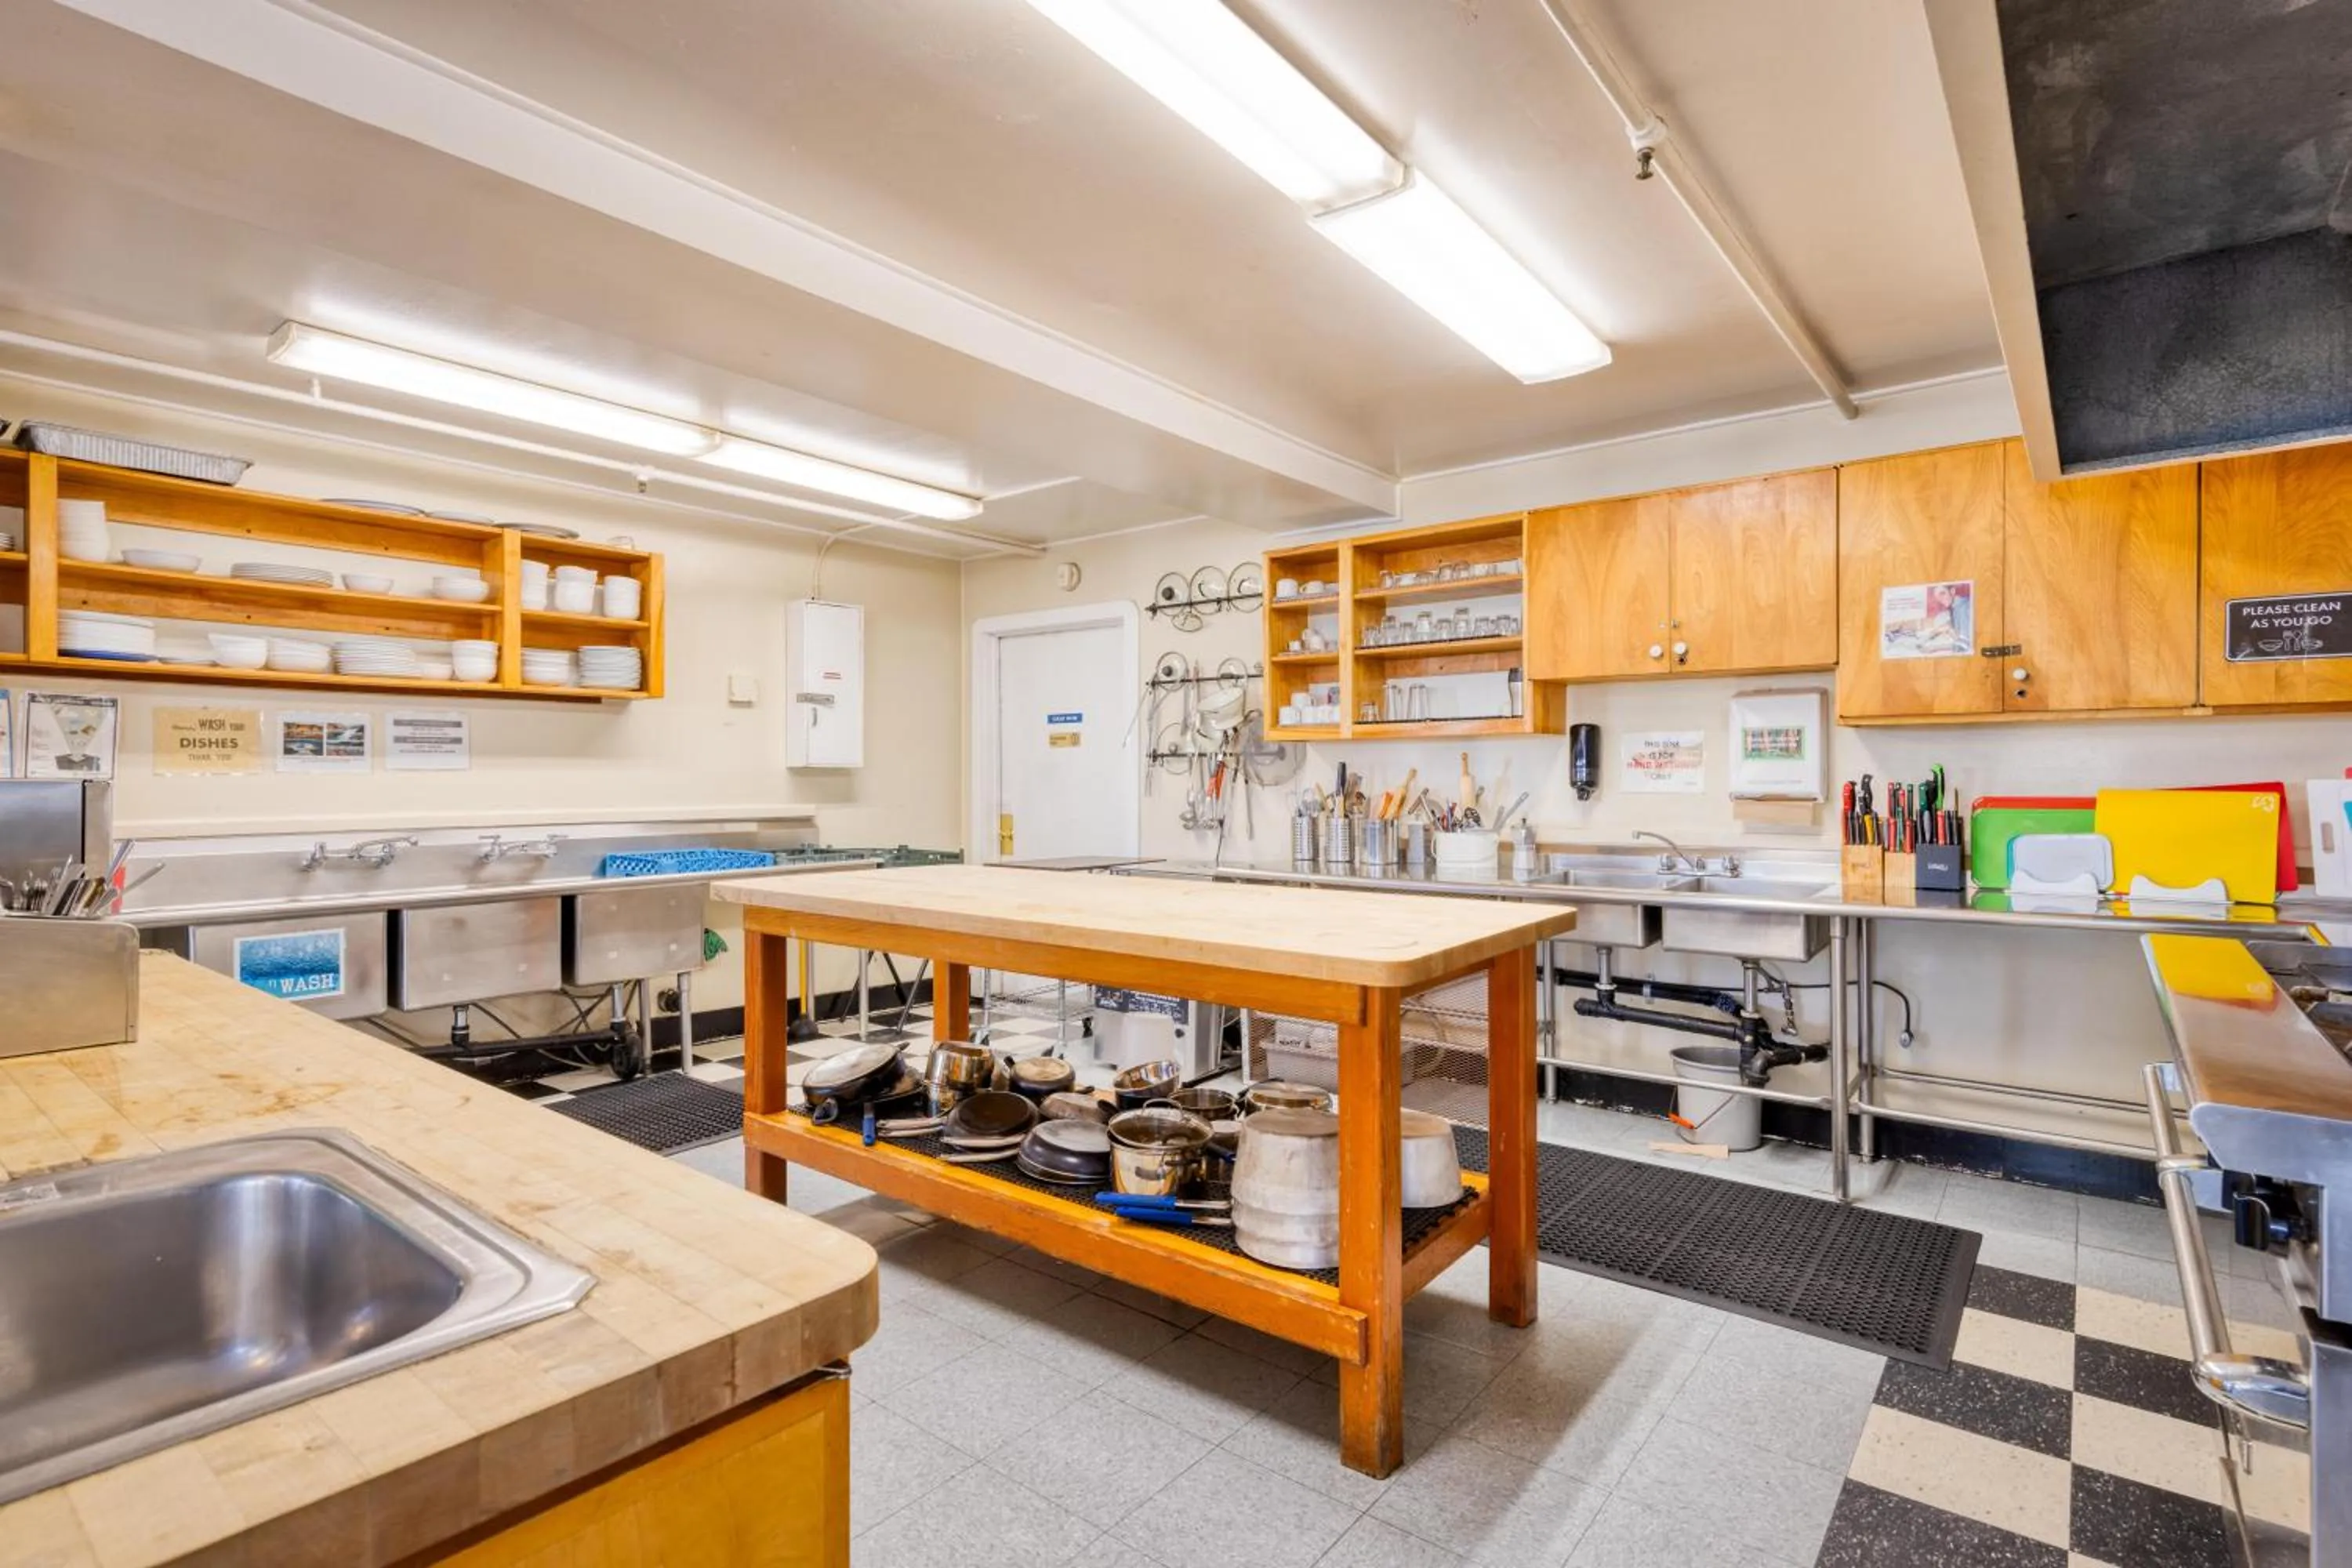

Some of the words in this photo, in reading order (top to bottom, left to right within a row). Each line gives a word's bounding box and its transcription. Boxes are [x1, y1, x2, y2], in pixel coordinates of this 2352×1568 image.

[2242, 604, 2291, 616] PLEASE
[2294, 601, 2342, 613] CLEAN
[2250, 619, 2269, 628] AS
[2273, 617, 2303, 626] YOU
[2307, 615, 2332, 626] GO
[198, 718, 226, 731] WASH
[180, 738, 238, 749] DISHES
[281, 973, 336, 994] WASH
